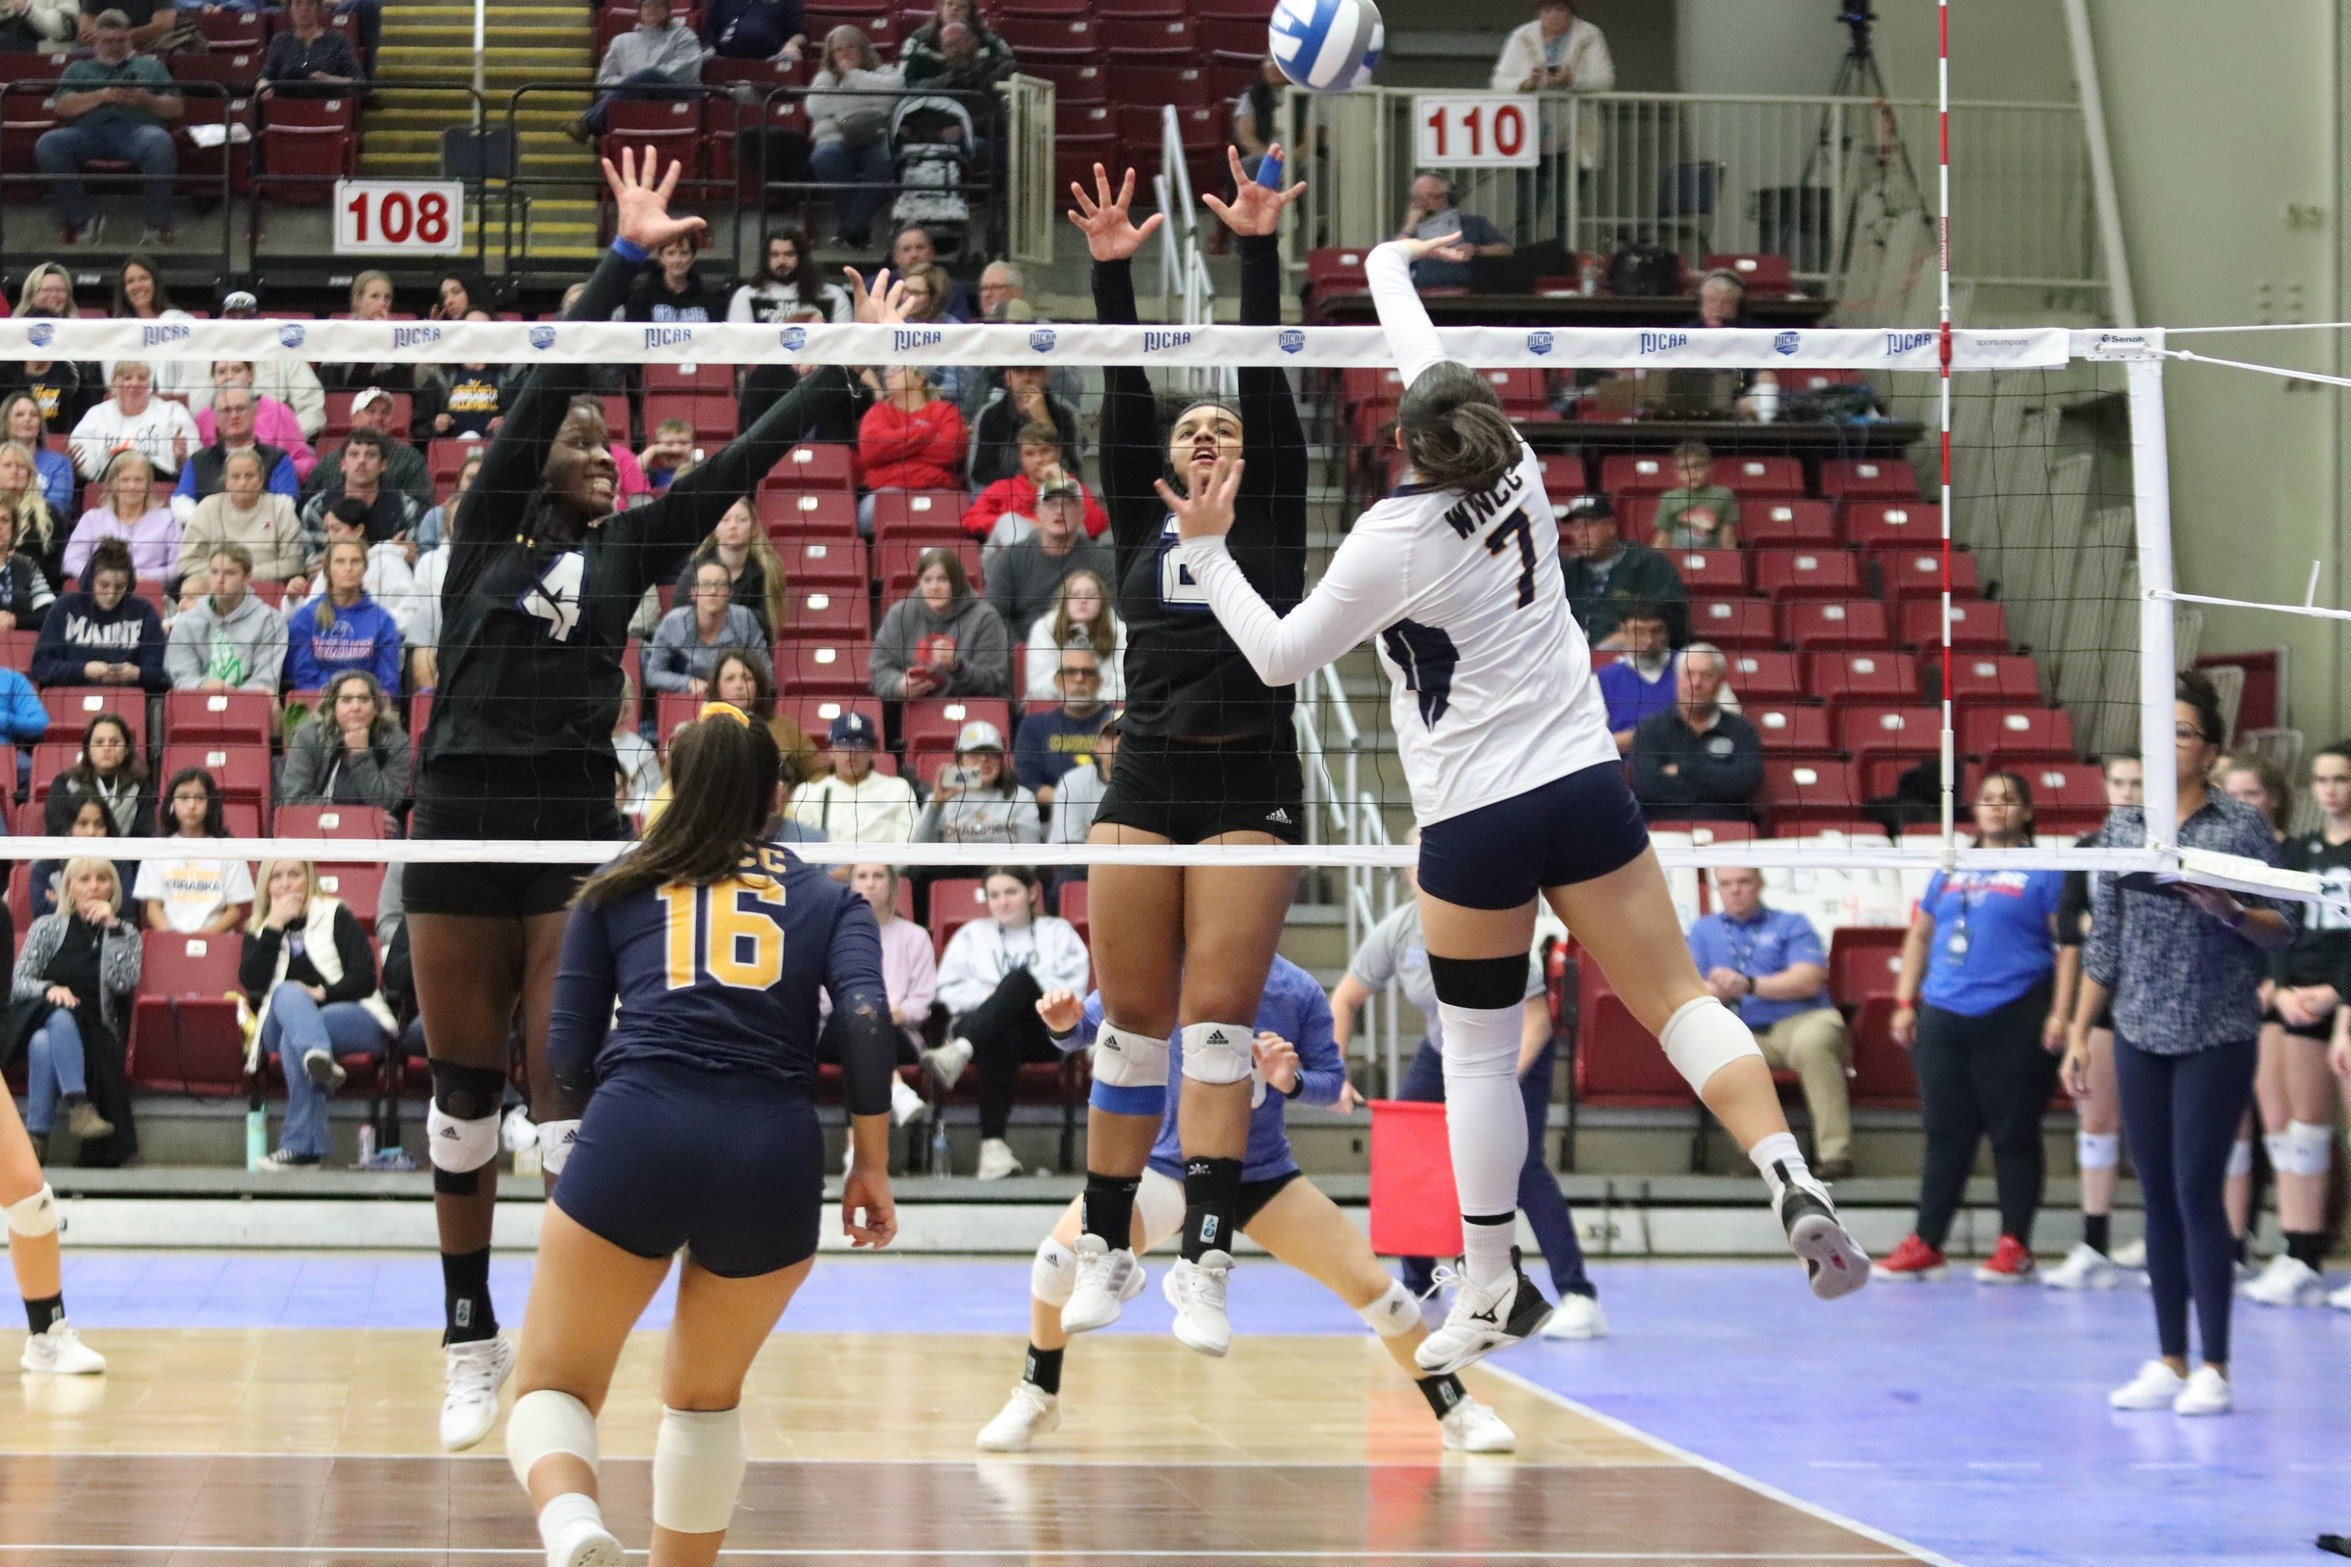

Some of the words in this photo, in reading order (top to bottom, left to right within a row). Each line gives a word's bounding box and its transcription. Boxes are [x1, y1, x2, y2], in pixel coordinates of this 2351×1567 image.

[1428, 105, 1525, 156] 110
[348, 191, 449, 243] 108
[142, 324, 190, 347] NJCAA
[393, 326, 442, 347] NJCAA
[645, 328, 692, 350] NJCAA
[894, 330, 941, 352] NJCAA
[1144, 331, 1191, 353] NJCAA
[1278, 333, 1305, 346] NJCAA
[1527, 334, 1554, 347] NJCAA
[1640, 332, 1688, 355] NJCAA
[1886, 333, 1933, 356] NJCAA
[2111, 335, 2145, 343] Senoh
[1444, 474, 1523, 540] WNCC
[1484, 506, 1538, 611] 7
[517, 551, 587, 643] 4
[65, 611, 144, 650] MAINE
[655, 872, 787, 992] 16
